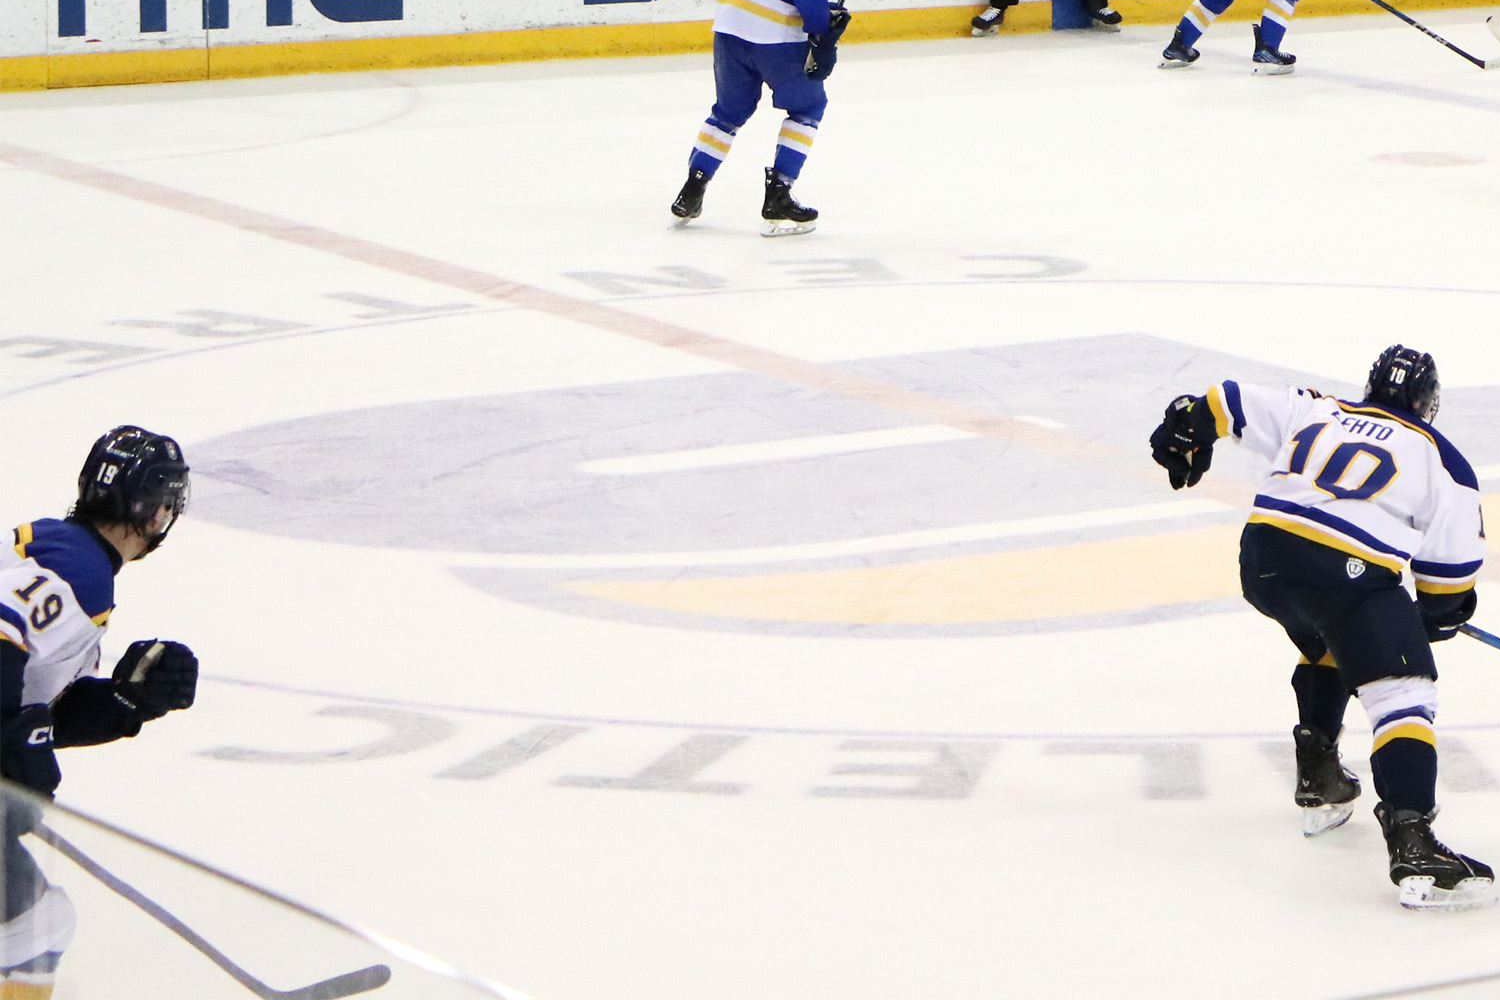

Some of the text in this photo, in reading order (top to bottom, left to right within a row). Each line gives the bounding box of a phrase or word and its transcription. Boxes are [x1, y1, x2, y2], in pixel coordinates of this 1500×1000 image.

[1389, 366, 1407, 385] 10
[96, 462, 118, 485] 19
[1271, 420, 1399, 502] 10
[12, 574, 64, 634] 19
